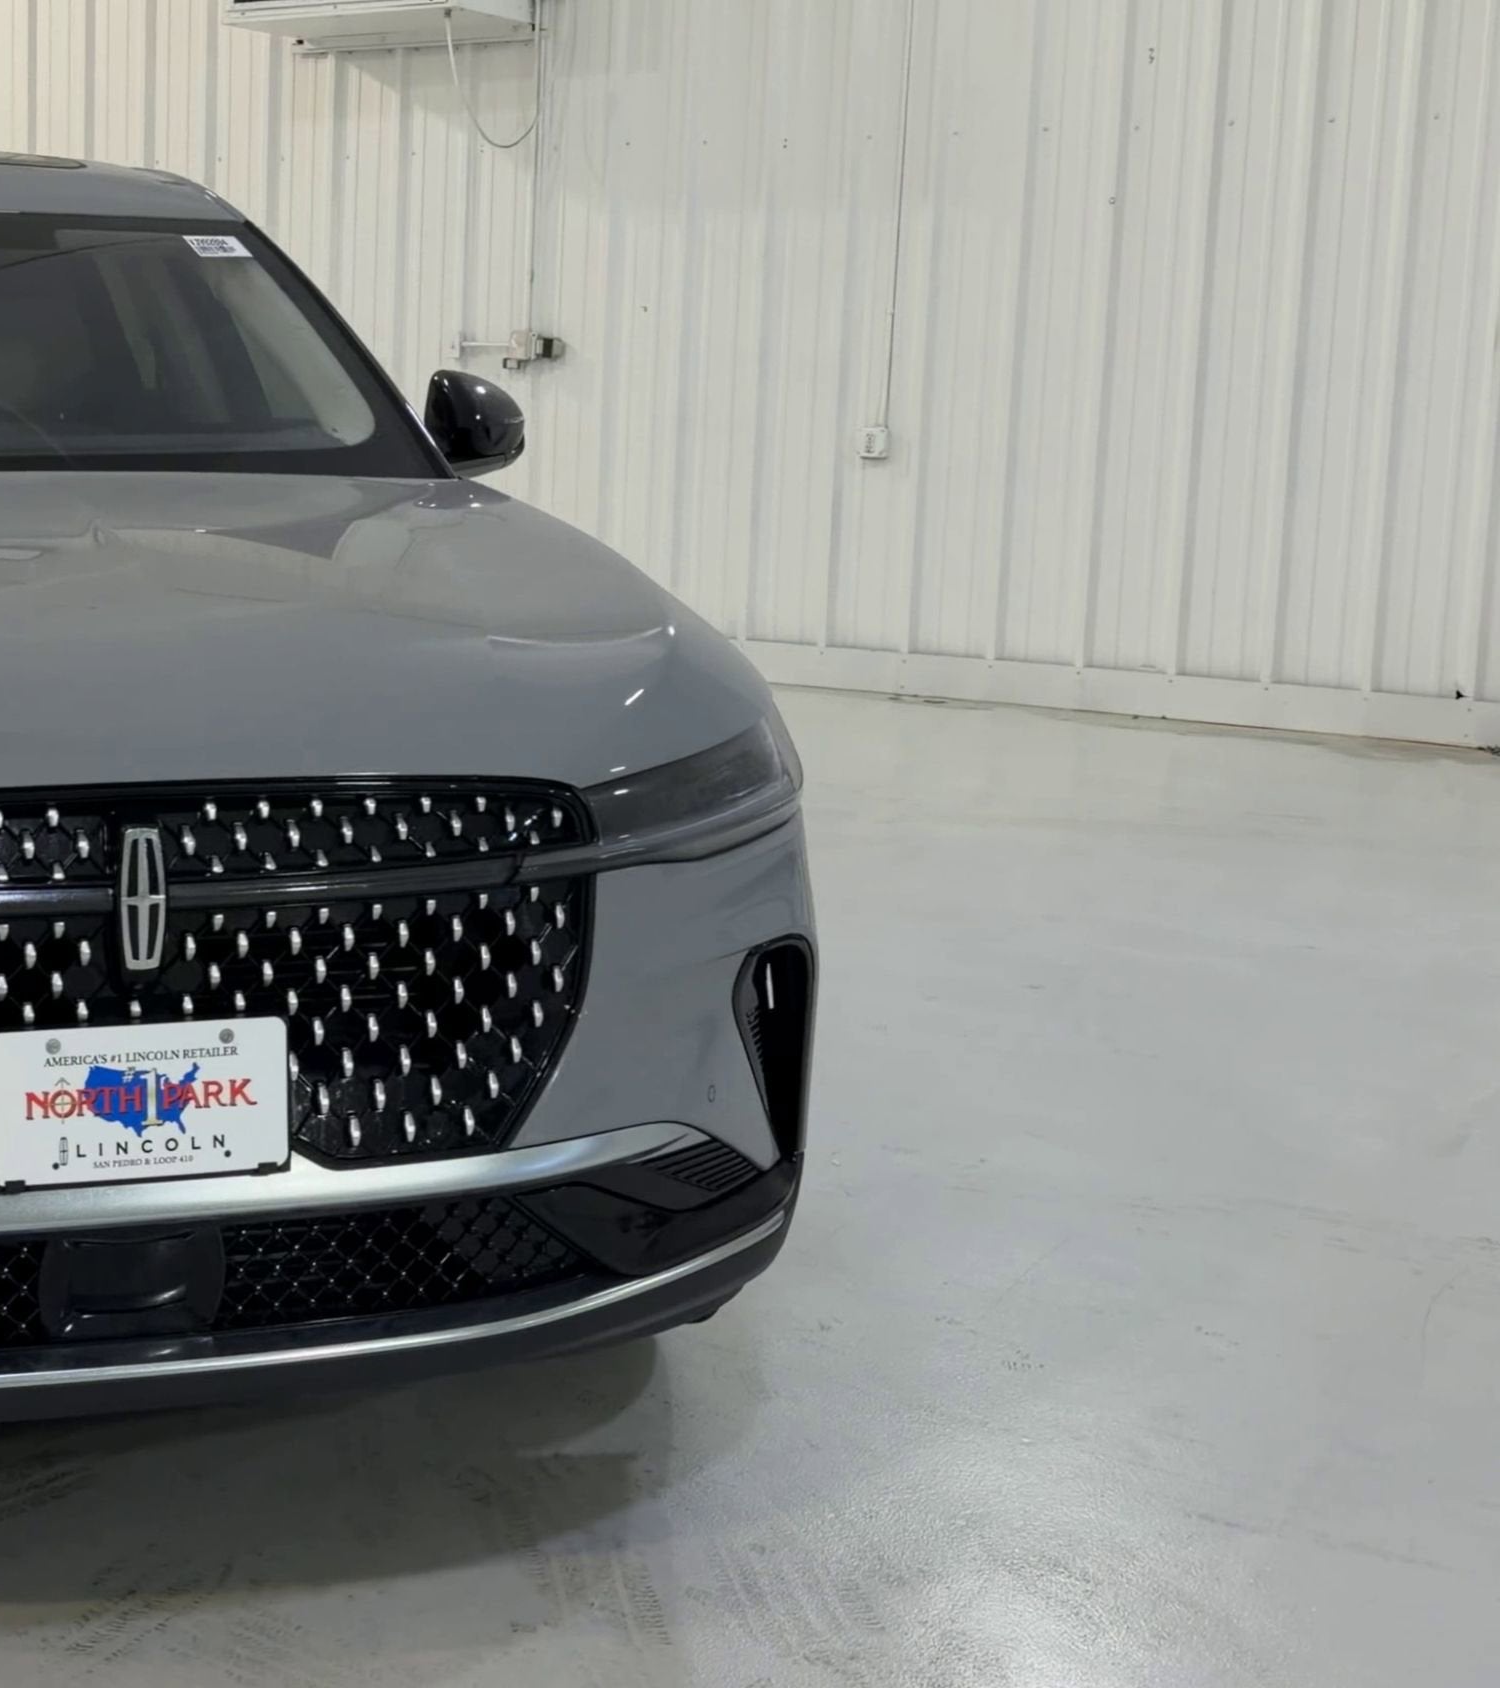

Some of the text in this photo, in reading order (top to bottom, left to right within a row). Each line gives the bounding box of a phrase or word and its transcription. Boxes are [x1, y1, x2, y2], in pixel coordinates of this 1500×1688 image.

[44, 1046, 238, 1067] AMERICA'S #1 LINCOLN RETAILER
[25, 1078, 258, 1120] NORTH PARK
[76, 1134, 226, 1158] LINCOLN
[93, 1159, 111, 1169] SAN
[112, 1158, 143, 1167] PEDRO
[153, 1156, 177, 1164] LOOP
[179, 1154, 194, 1163] 410
